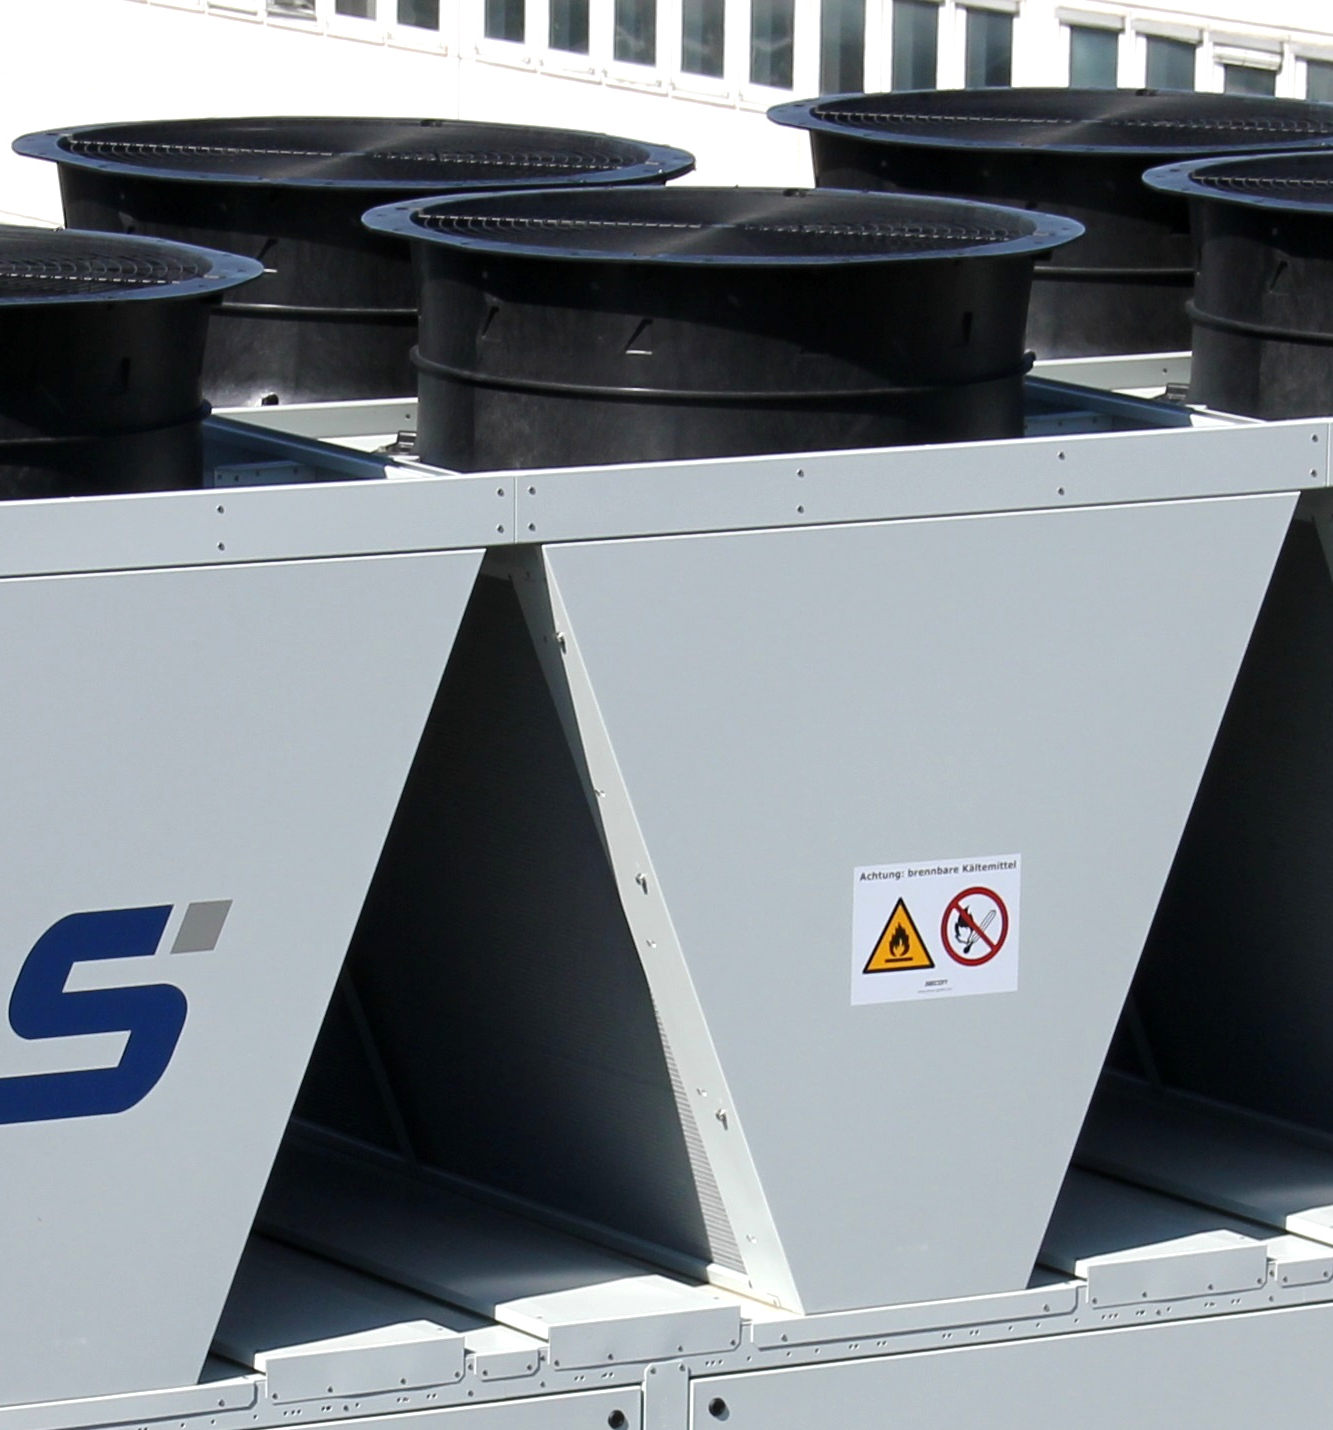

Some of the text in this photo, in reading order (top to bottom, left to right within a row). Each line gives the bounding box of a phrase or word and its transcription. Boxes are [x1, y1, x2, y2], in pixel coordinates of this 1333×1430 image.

[859, 860, 1017, 882] Achtung: brennbare Kältemittel
